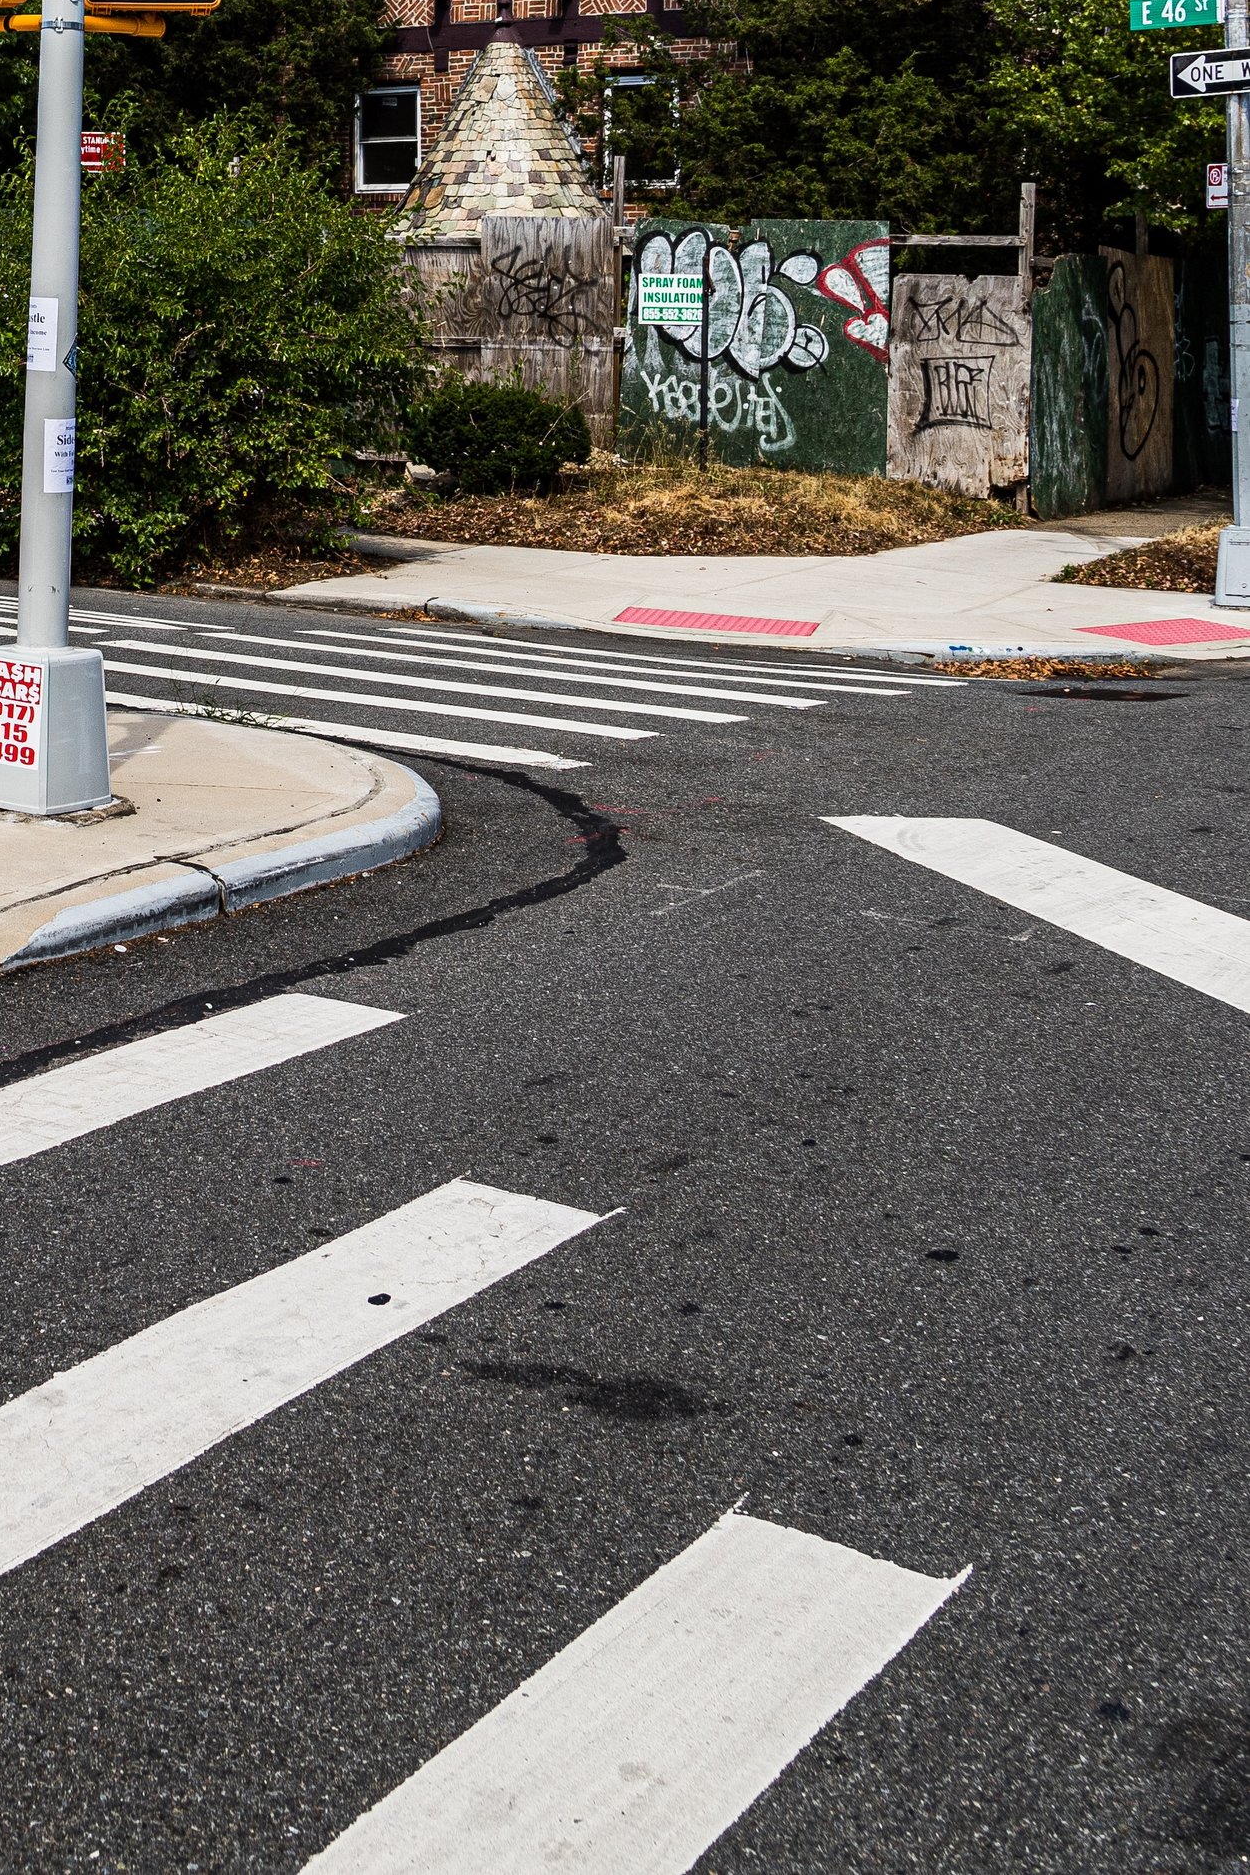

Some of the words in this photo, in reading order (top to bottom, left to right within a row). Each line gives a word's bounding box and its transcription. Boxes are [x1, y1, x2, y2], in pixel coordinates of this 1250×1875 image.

[1142, 0, 1153, 25] E
[1191, 64, 1225, 82] ONE
[642, 277, 674, 288] SPRAY
[643, 292, 703, 304] INSULATION
